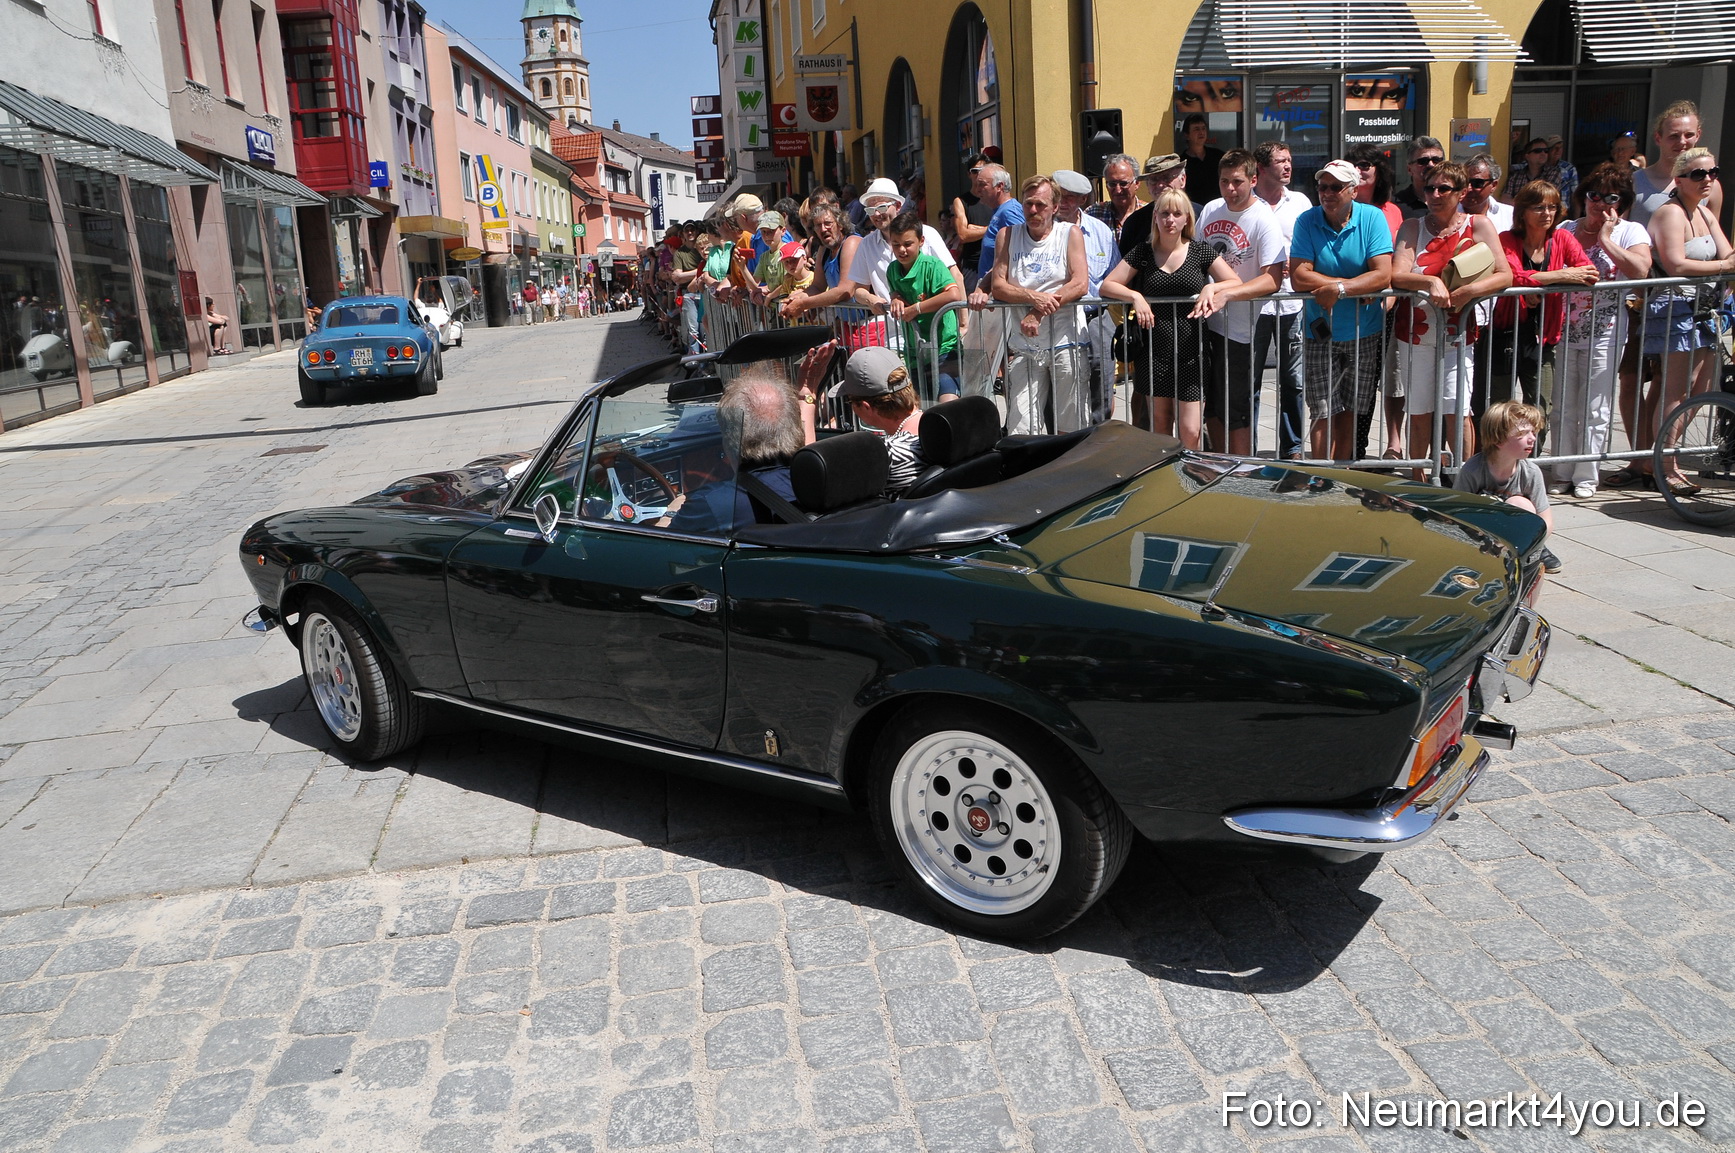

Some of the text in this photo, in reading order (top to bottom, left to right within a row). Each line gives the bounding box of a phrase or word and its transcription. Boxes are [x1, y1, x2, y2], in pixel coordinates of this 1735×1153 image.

[798, 59, 836, 69] RATHAUS
[735, 20, 764, 147] KIWI
[1276, 87, 1311, 108] FOTO
[1262, 106, 1323, 122] hailer
[1358, 117, 1400, 127] Passbilder
[1459, 121, 1481, 134] FOTO
[691, 97, 715, 179] WITT
[1345, 133, 1413, 144] Bewerbungsbilder
[1454, 132, 1488, 142] hailer
[482, 187, 494, 200] B
[697, 184, 725, 194] WITT
[355, 350, 366, 358] RH
[351, 358, 361, 366] GT
